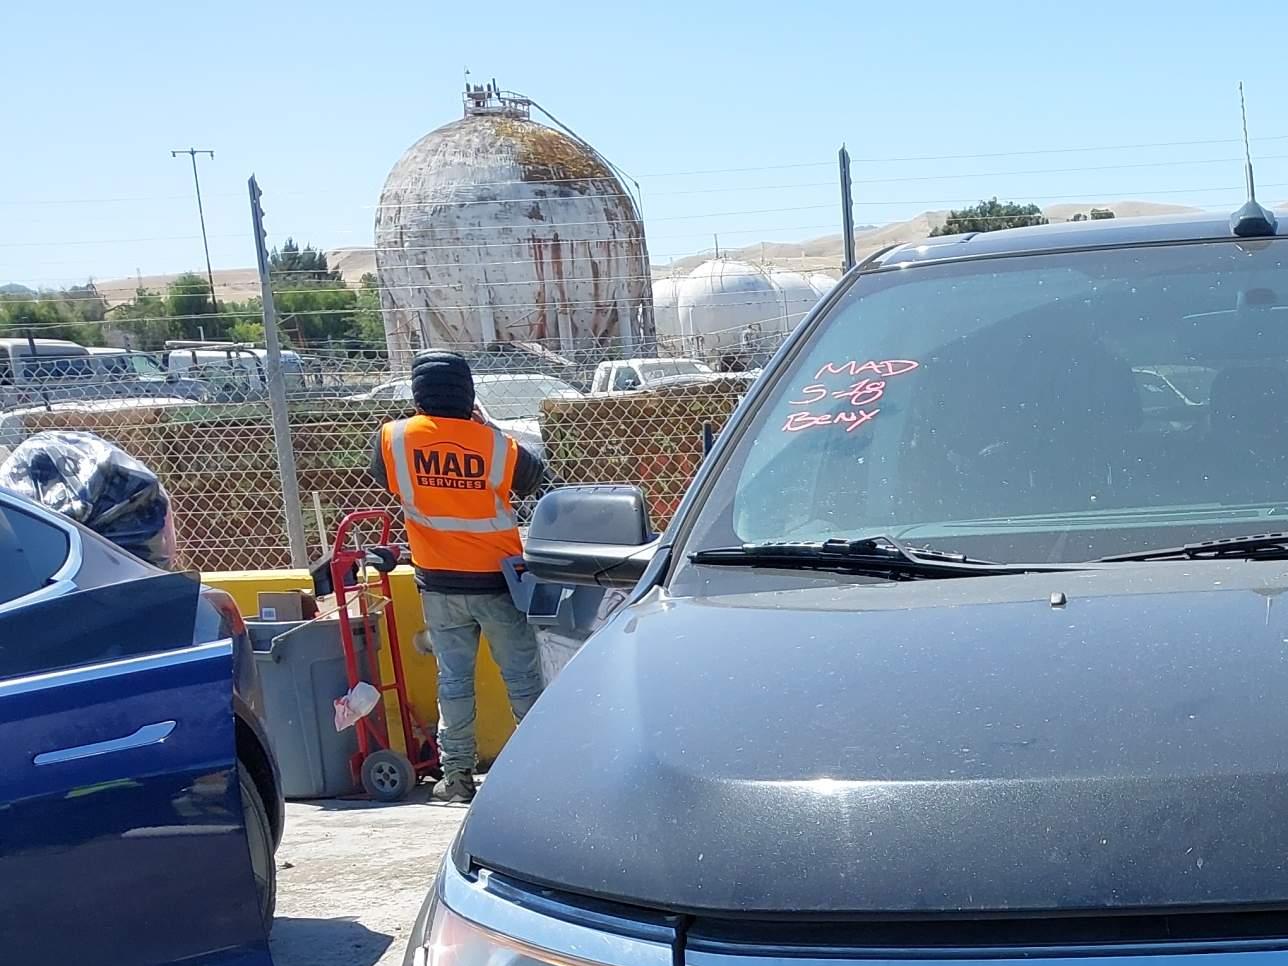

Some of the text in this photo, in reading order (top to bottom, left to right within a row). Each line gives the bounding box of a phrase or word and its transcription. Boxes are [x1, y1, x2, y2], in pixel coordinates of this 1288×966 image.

[814, 359, 919, 380] MAD
[413, 448, 485, 478] MAD
[420, 477, 483, 489] SERVICES
